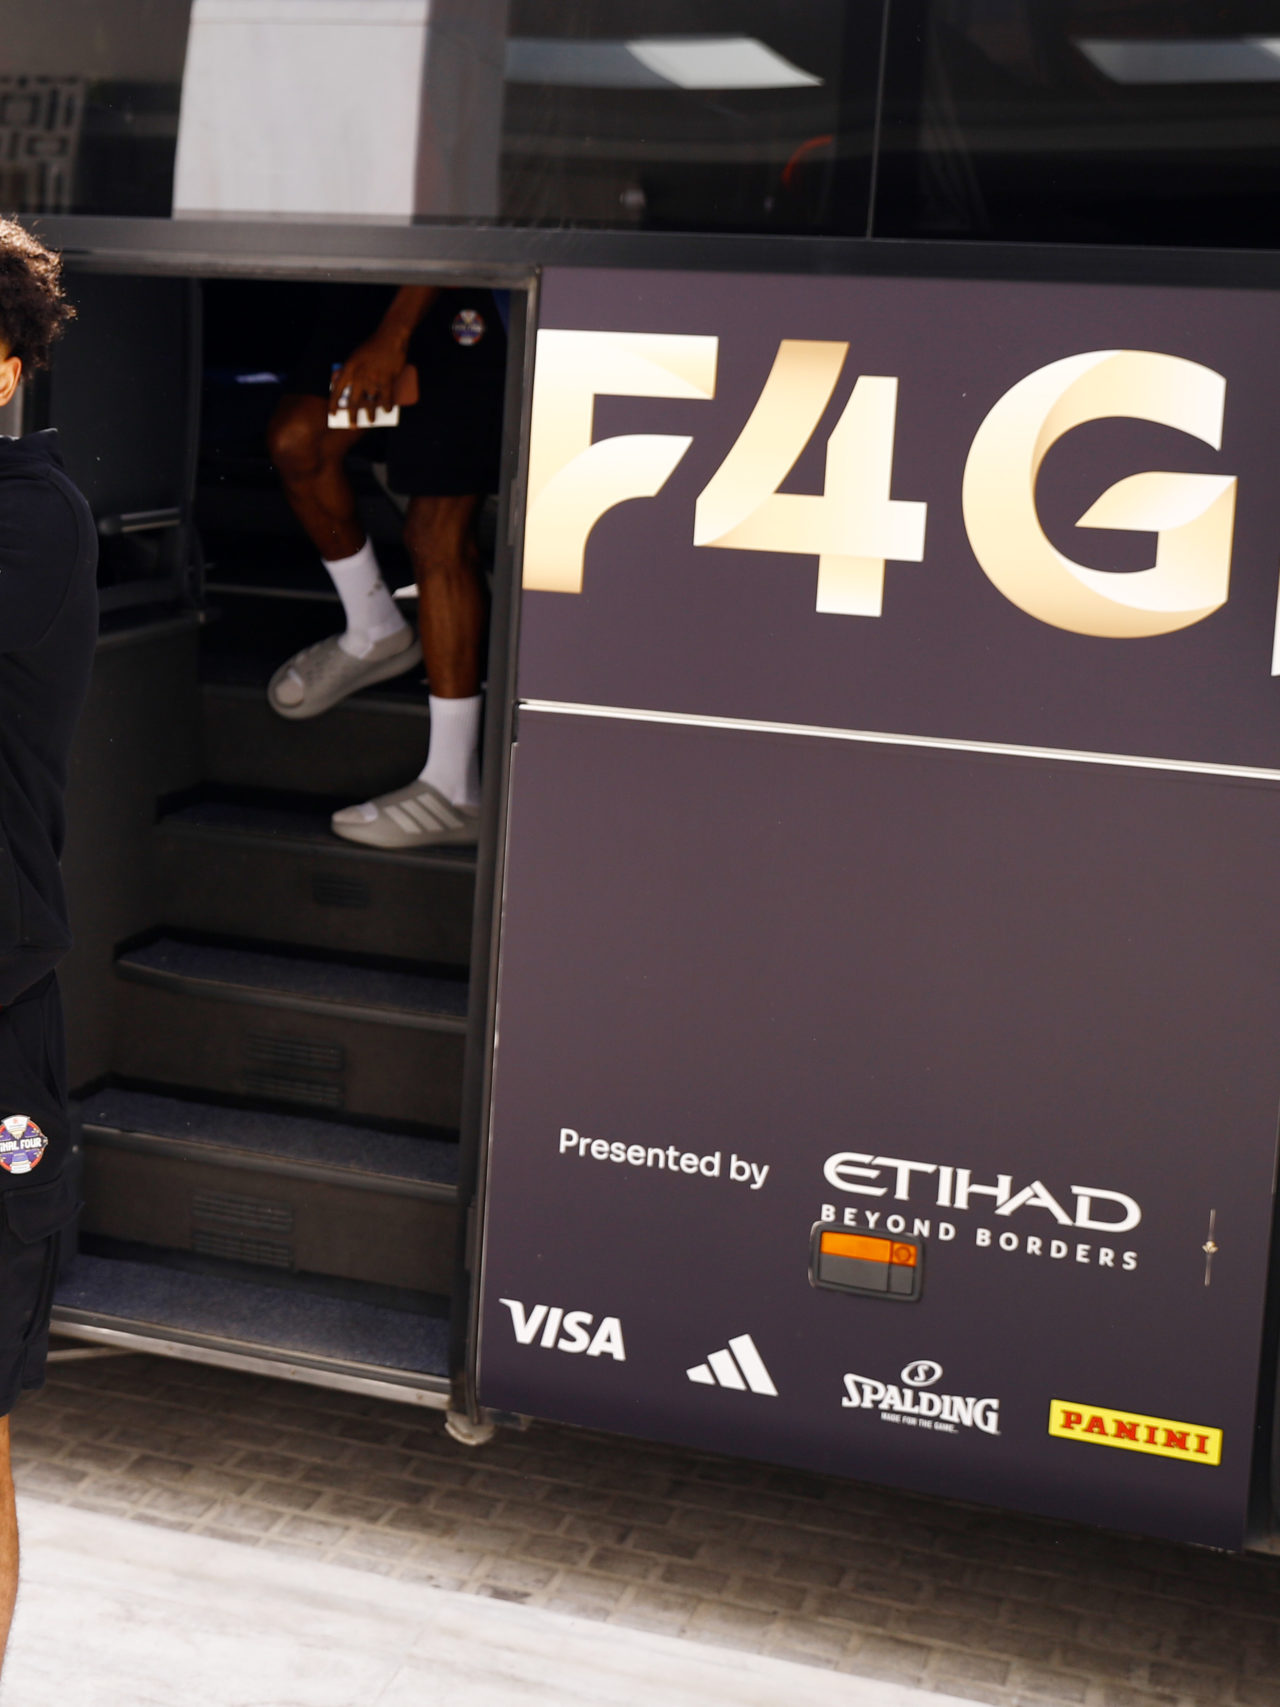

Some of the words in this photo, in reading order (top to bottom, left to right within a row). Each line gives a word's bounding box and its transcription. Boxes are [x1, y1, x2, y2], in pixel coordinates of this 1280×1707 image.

[522, 328, 1280, 678] F4G
[20, 1137, 43, 1150] FOUR
[558, 1127, 722, 1178] Presented
[729, 1153, 770, 1190] by
[822, 1151, 1142, 1233] ETIHAD
[820, 1203, 957, 1242] BEYOND
[975, 1227, 1138, 1271] BORDERS
[498, 1297, 627, 1362] VISA
[841, 1372, 1002, 1436] SPALDING
[880, 1411, 901, 1424] MADE
[901, 1415, 918, 1427] FOR
[918, 1418, 933, 1430] THE
[1060, 1409, 1210, 1455] PANINI
